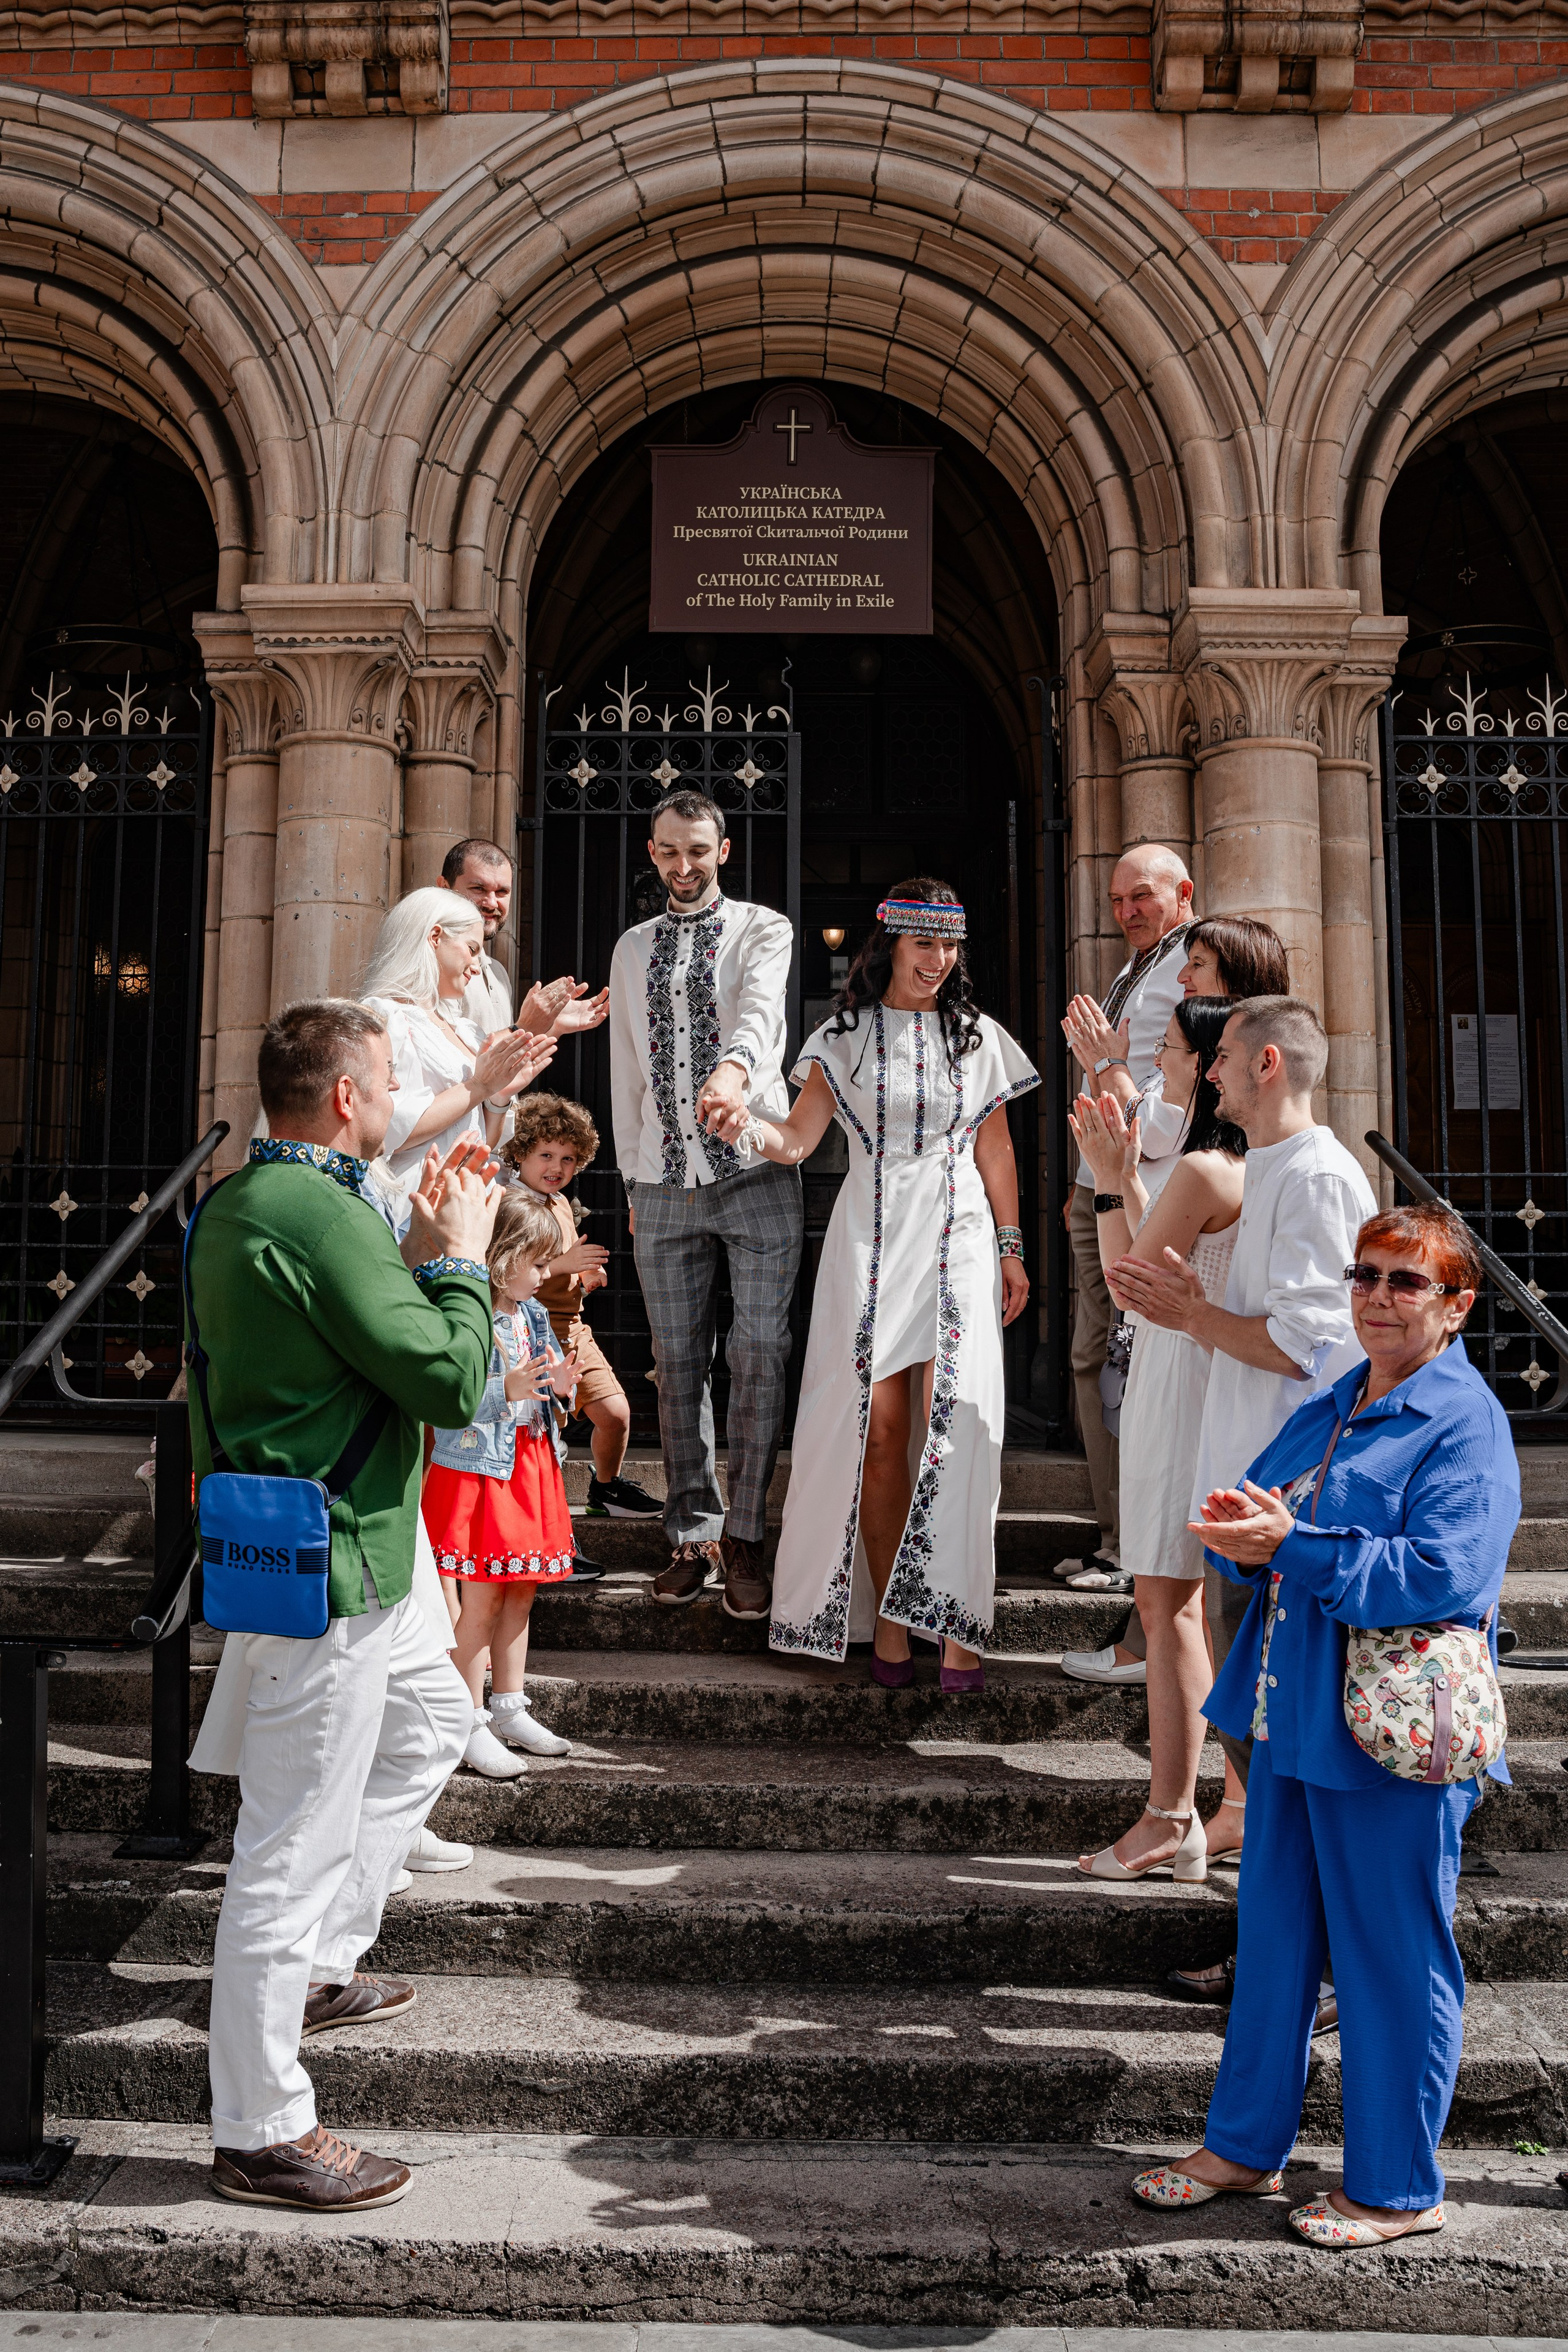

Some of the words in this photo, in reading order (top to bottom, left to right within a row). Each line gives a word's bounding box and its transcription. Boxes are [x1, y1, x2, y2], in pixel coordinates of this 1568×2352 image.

[739, 484, 843, 499] УКРАЇНСЬКА
[696, 507, 809, 521] КАТОЛИЦЬКА
[812, 507, 886, 522] КАТЕДРА
[673, 525, 753, 541] Пресвятої
[848, 526, 908, 541] Родини
[742, 553, 839, 567] UKRAINIAN
[697, 573, 780, 587] CATHOLIC
[784, 574, 884, 587] CATHEDRAL
[686, 593, 704, 606] of
[706, 593, 735, 607] The
[739, 594, 776, 611] Holy
[779, 594, 832, 611] Family
[836, 594, 852, 607] in
[856, 594, 894, 608] Exile
[228, 1541, 290, 1567] BOSS
[228, 1562, 254, 1571] HUGO
